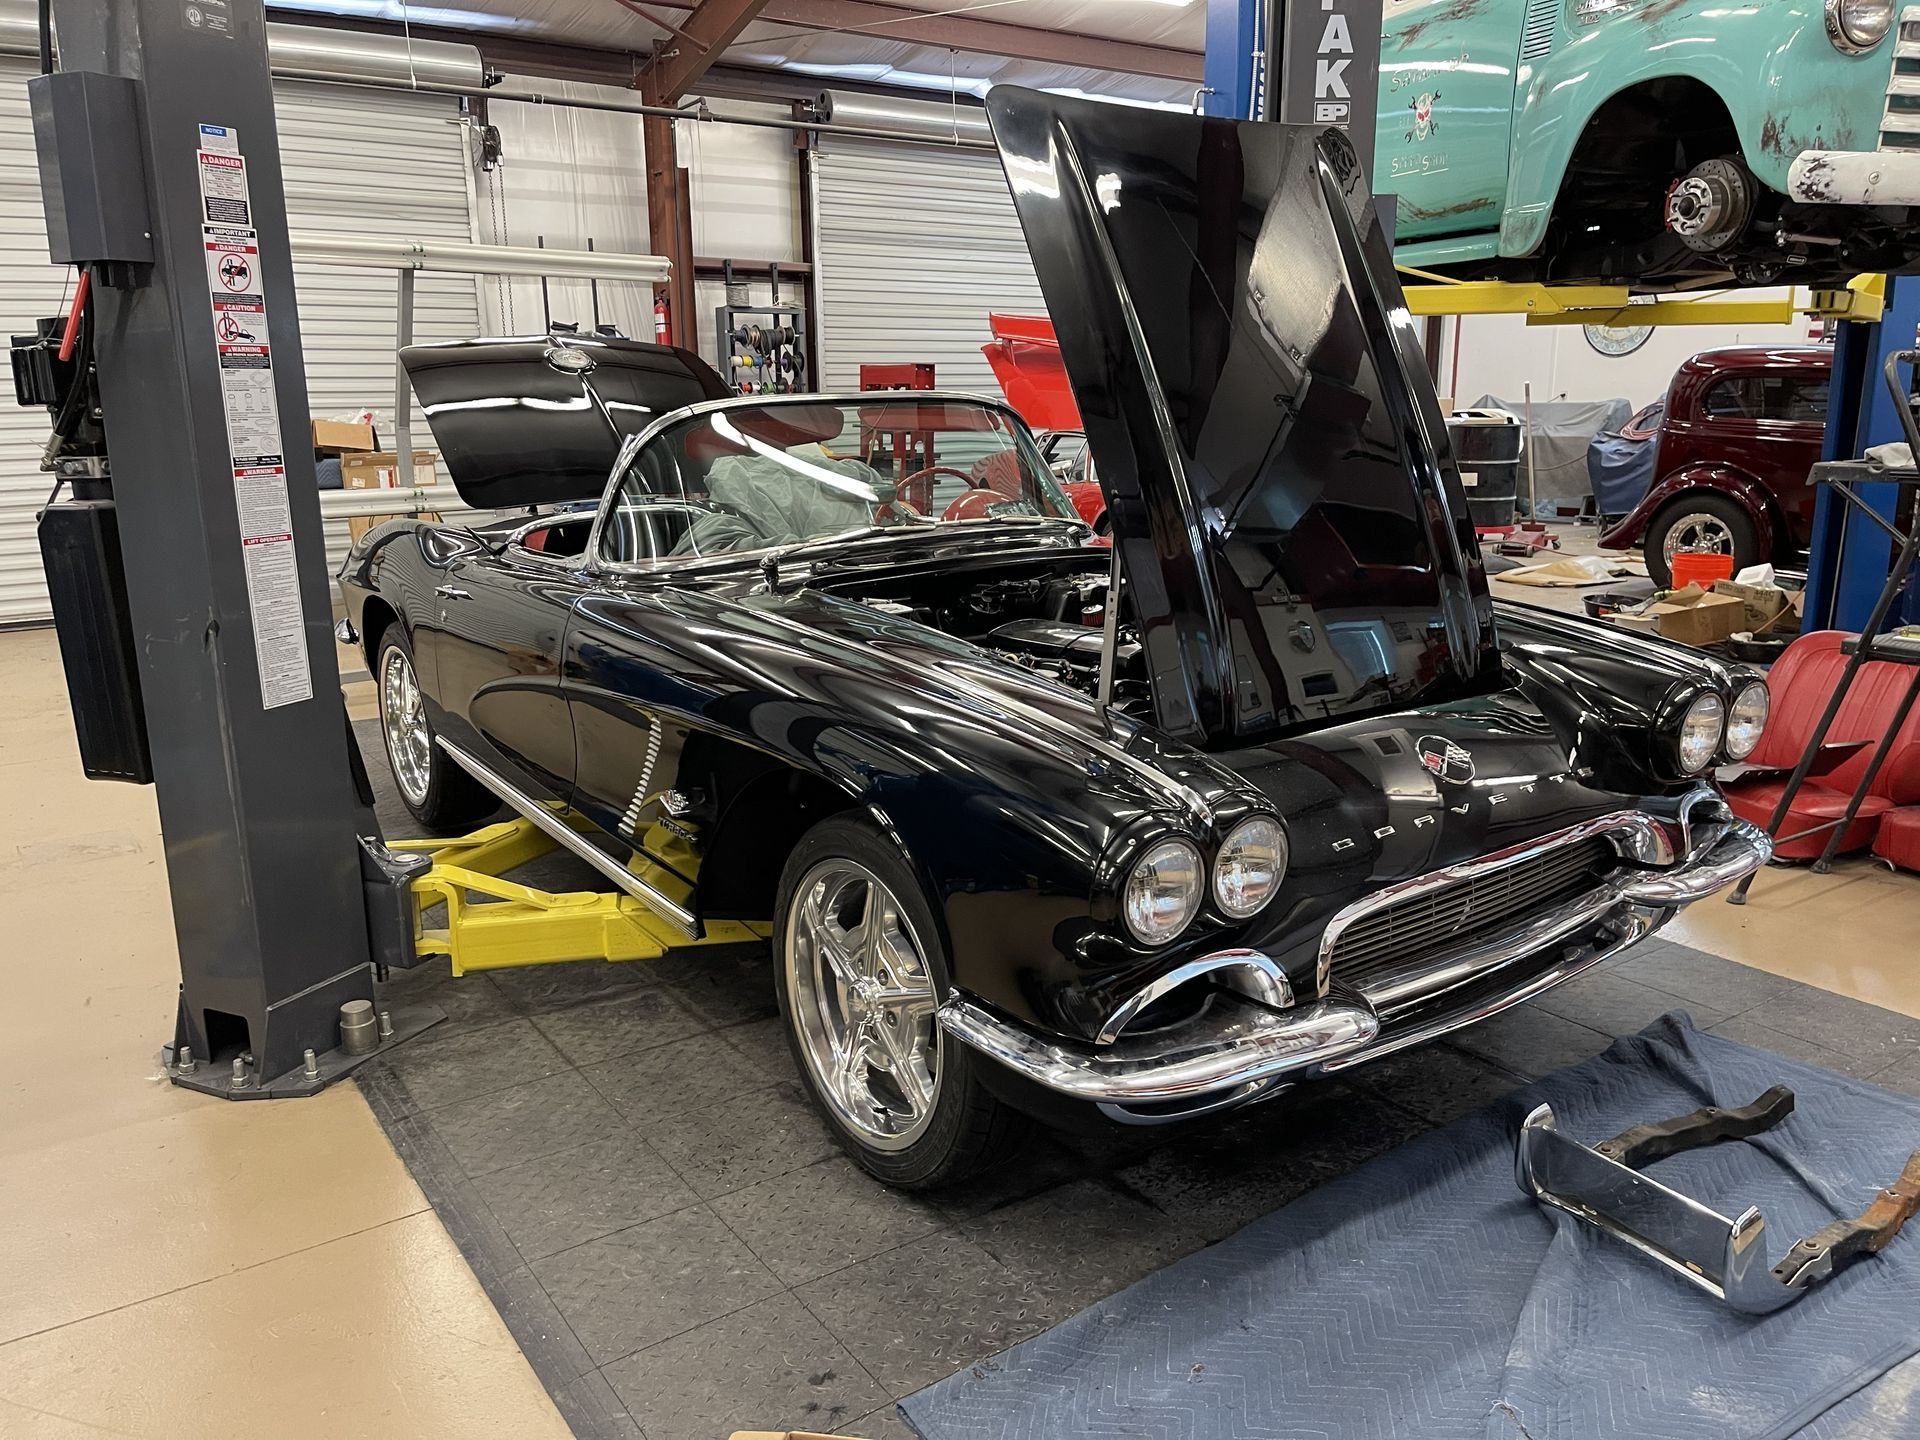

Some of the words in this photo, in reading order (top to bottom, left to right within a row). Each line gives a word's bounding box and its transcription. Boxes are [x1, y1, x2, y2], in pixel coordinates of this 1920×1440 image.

[1315, 0, 1354, 98] AK
[205, 127, 223, 135] NOTICE
[208, 156, 241, 168] DANGER
[213, 228, 251, 238] IMPORTANT
[219, 245, 246, 253] DANGER
[226, 304, 256, 312] CAUTION
[259, 535, 288, 543] OPERATION
